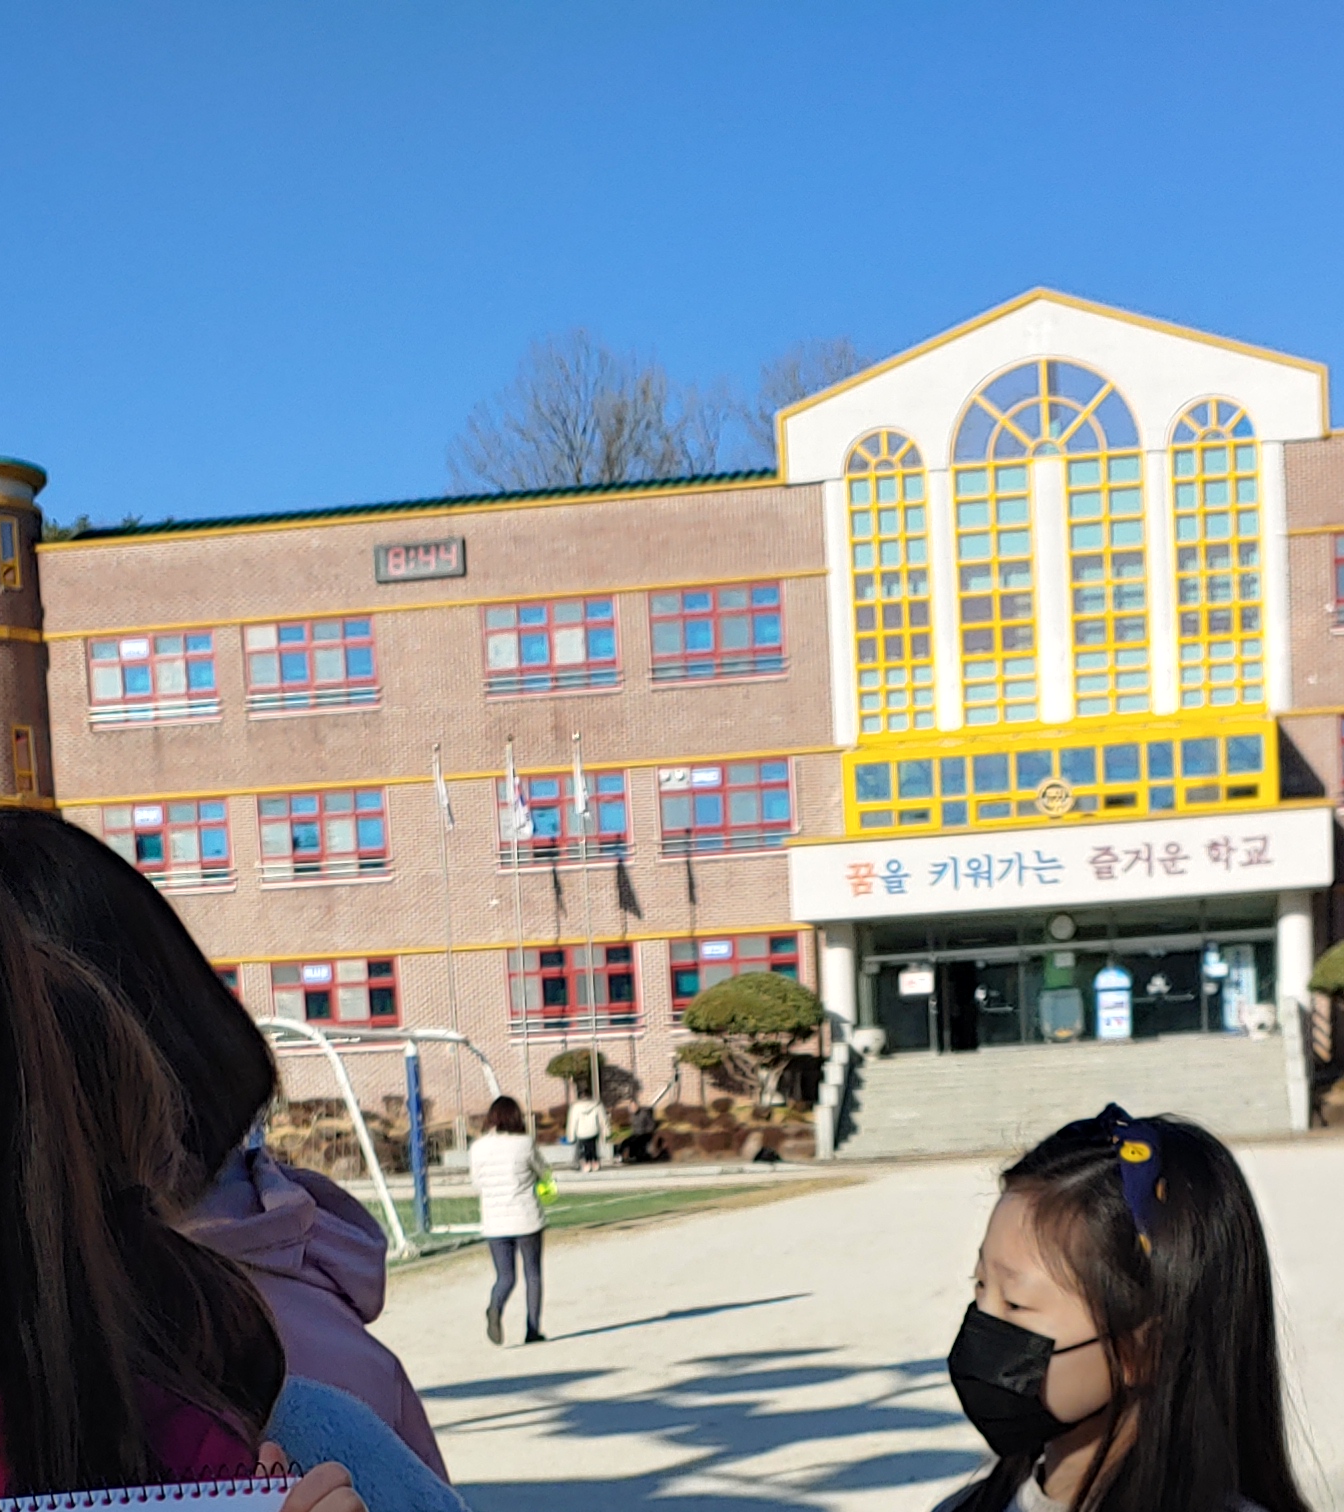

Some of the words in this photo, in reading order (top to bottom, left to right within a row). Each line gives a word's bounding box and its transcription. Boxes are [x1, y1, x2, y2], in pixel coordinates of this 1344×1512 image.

[846, 859, 909, 896] 꿈을
[928, 851, 1064, 889] 키워가는
[1088, 841, 1191, 880] 즐거운
[1206, 834, 1272, 870] 학교
